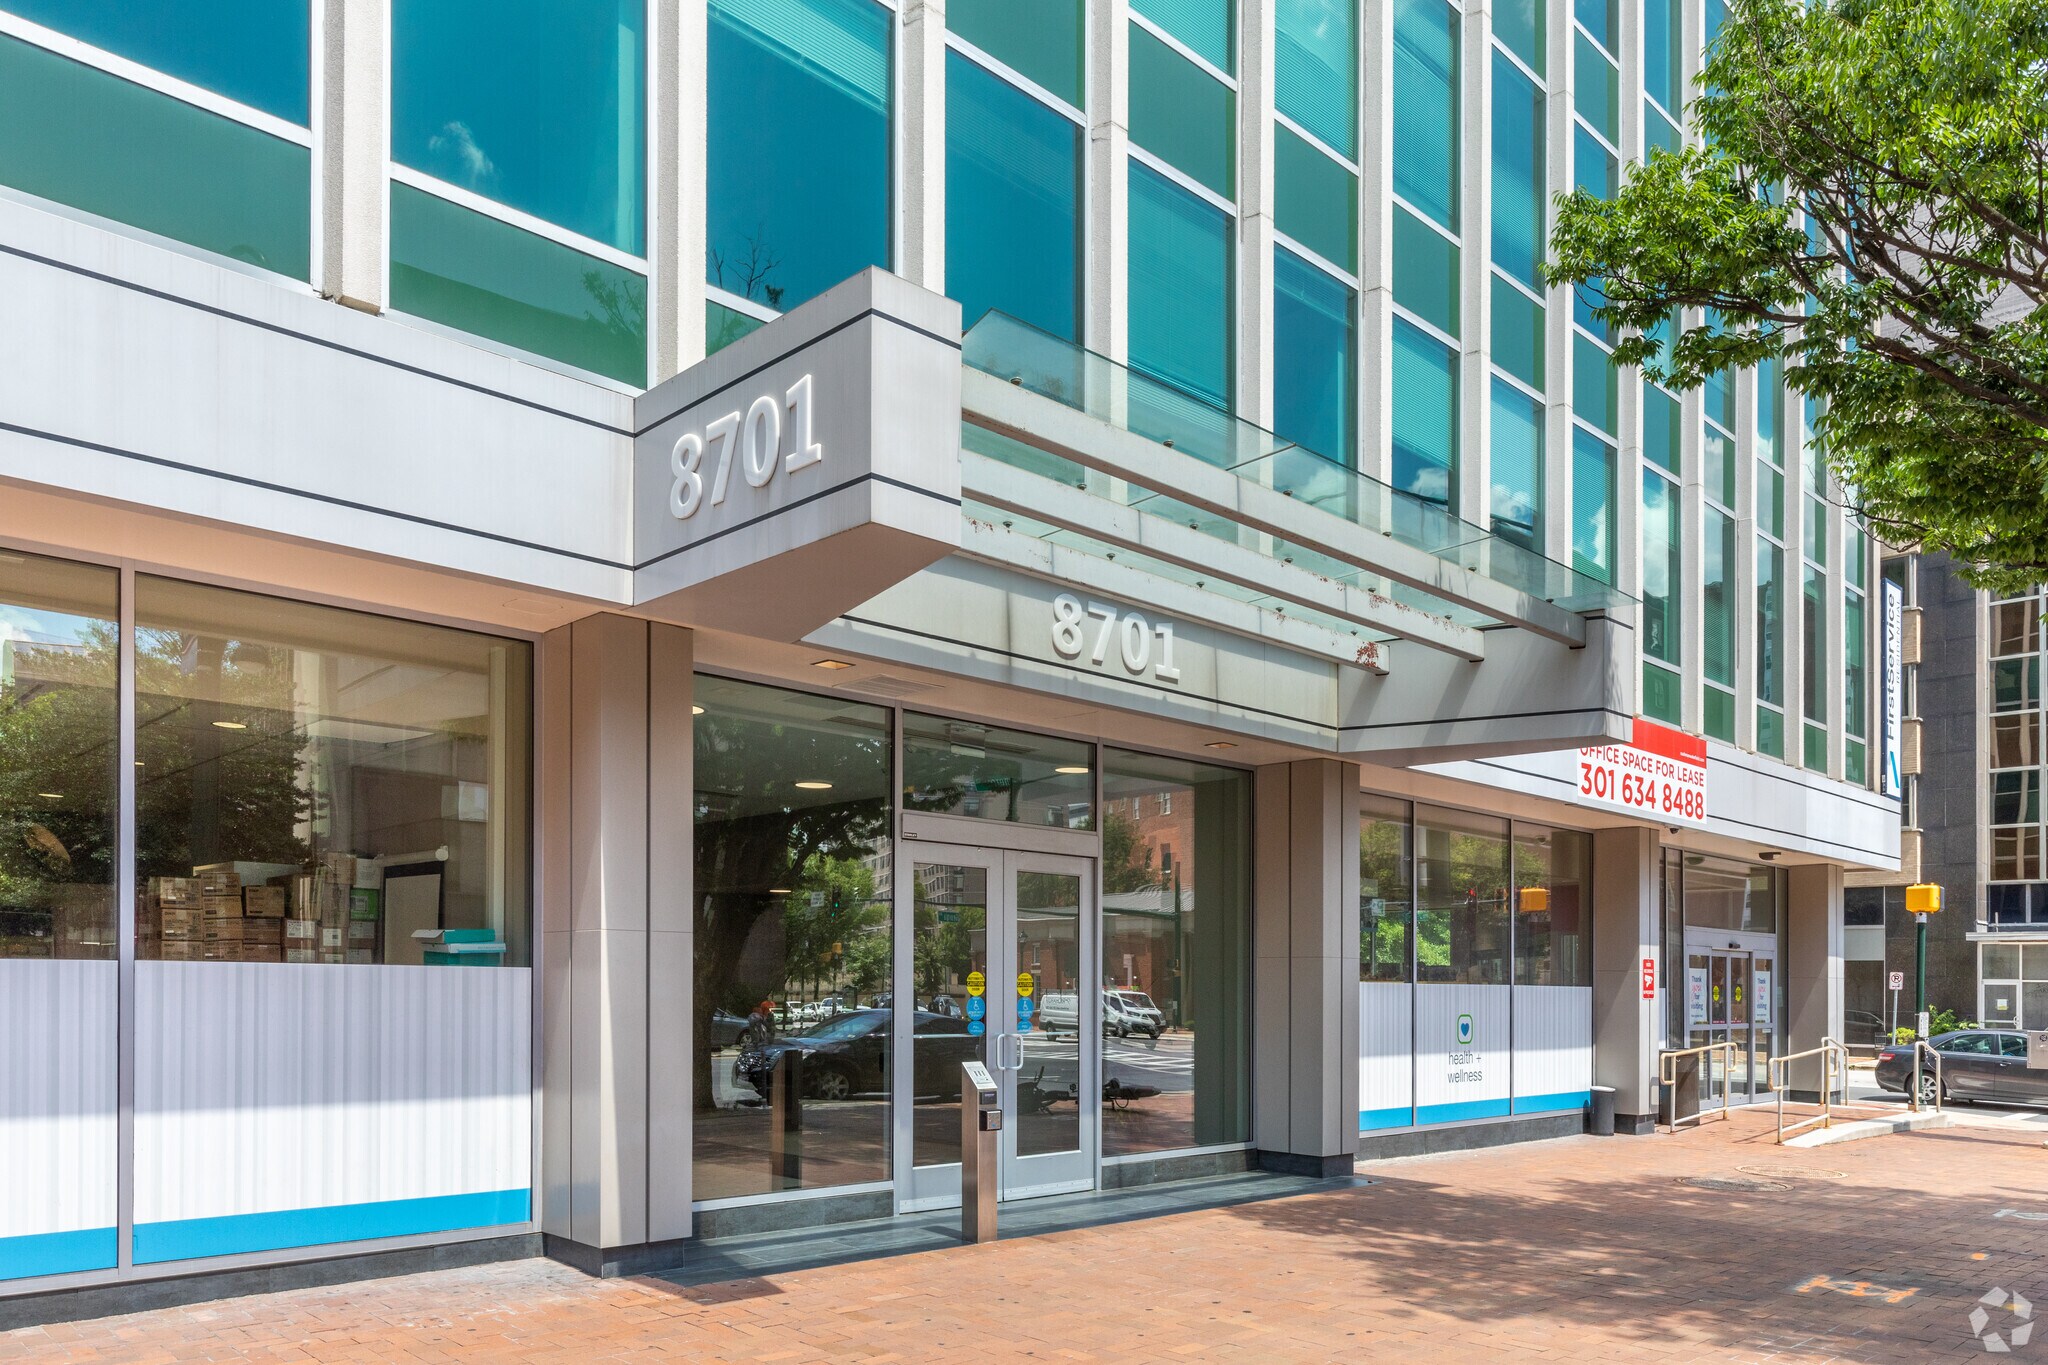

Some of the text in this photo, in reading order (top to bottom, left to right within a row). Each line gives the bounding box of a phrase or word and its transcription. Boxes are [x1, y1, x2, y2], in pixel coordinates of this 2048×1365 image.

[669, 373, 822, 520] 8701
[1052, 593, 1180, 681] 8701
[1887, 593, 1895, 741] FirstService
[1580, 762, 1704, 820] 301 634 8488
[1622, 751, 1653, 774] SPACE
[1656, 760, 1675, 779] FOR
[1677, 766, 1704, 787] LEASE
[1447, 1069, 1483, 1084] wellness
[1448, 1050, 1474, 1065] health
